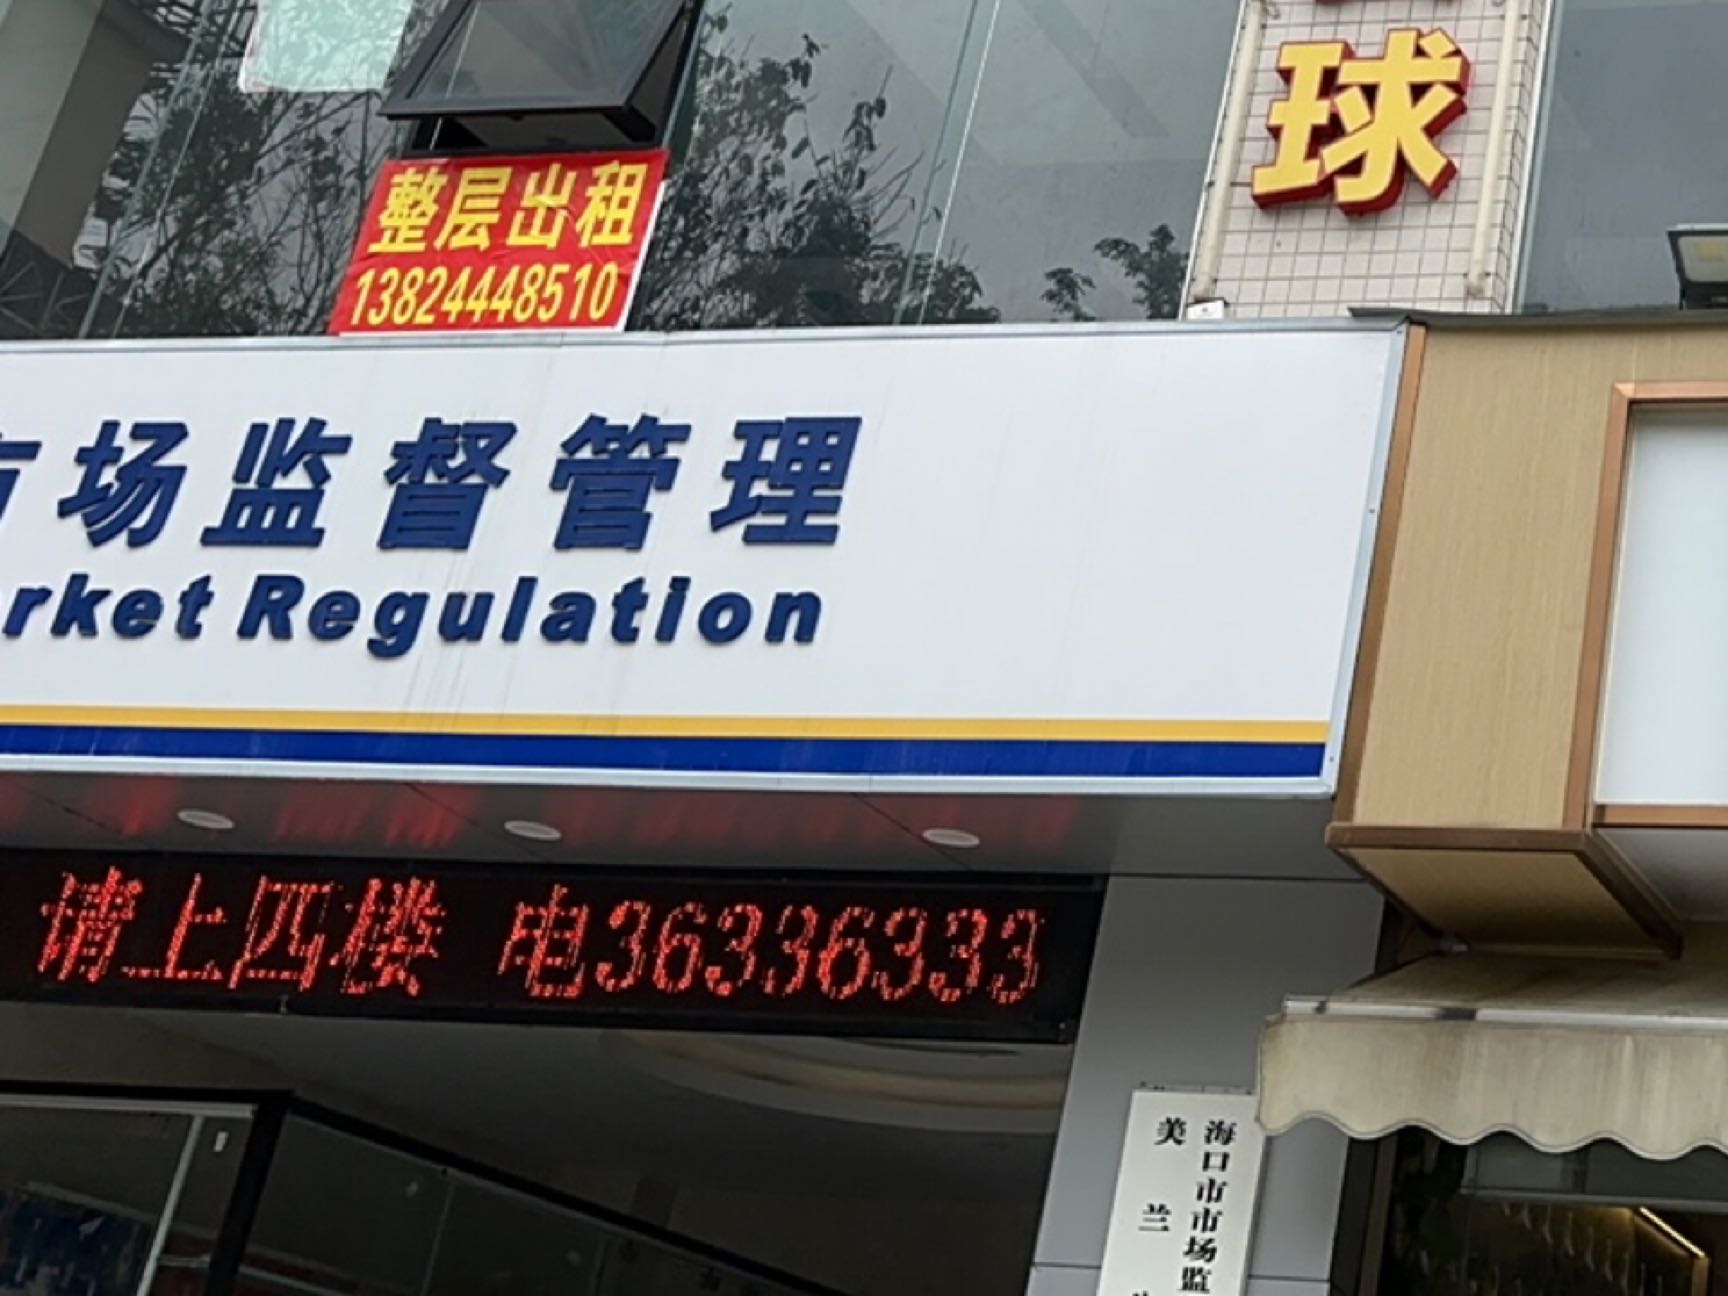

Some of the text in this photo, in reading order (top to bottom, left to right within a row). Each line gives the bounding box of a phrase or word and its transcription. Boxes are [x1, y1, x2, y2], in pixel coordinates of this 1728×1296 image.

[368, 161, 648, 253] 整层出租
[351, 262, 618, 325] 13824448510
[236, 574, 823, 658] Regulation
[1132, 1116, 1187, 1296] 美兰
